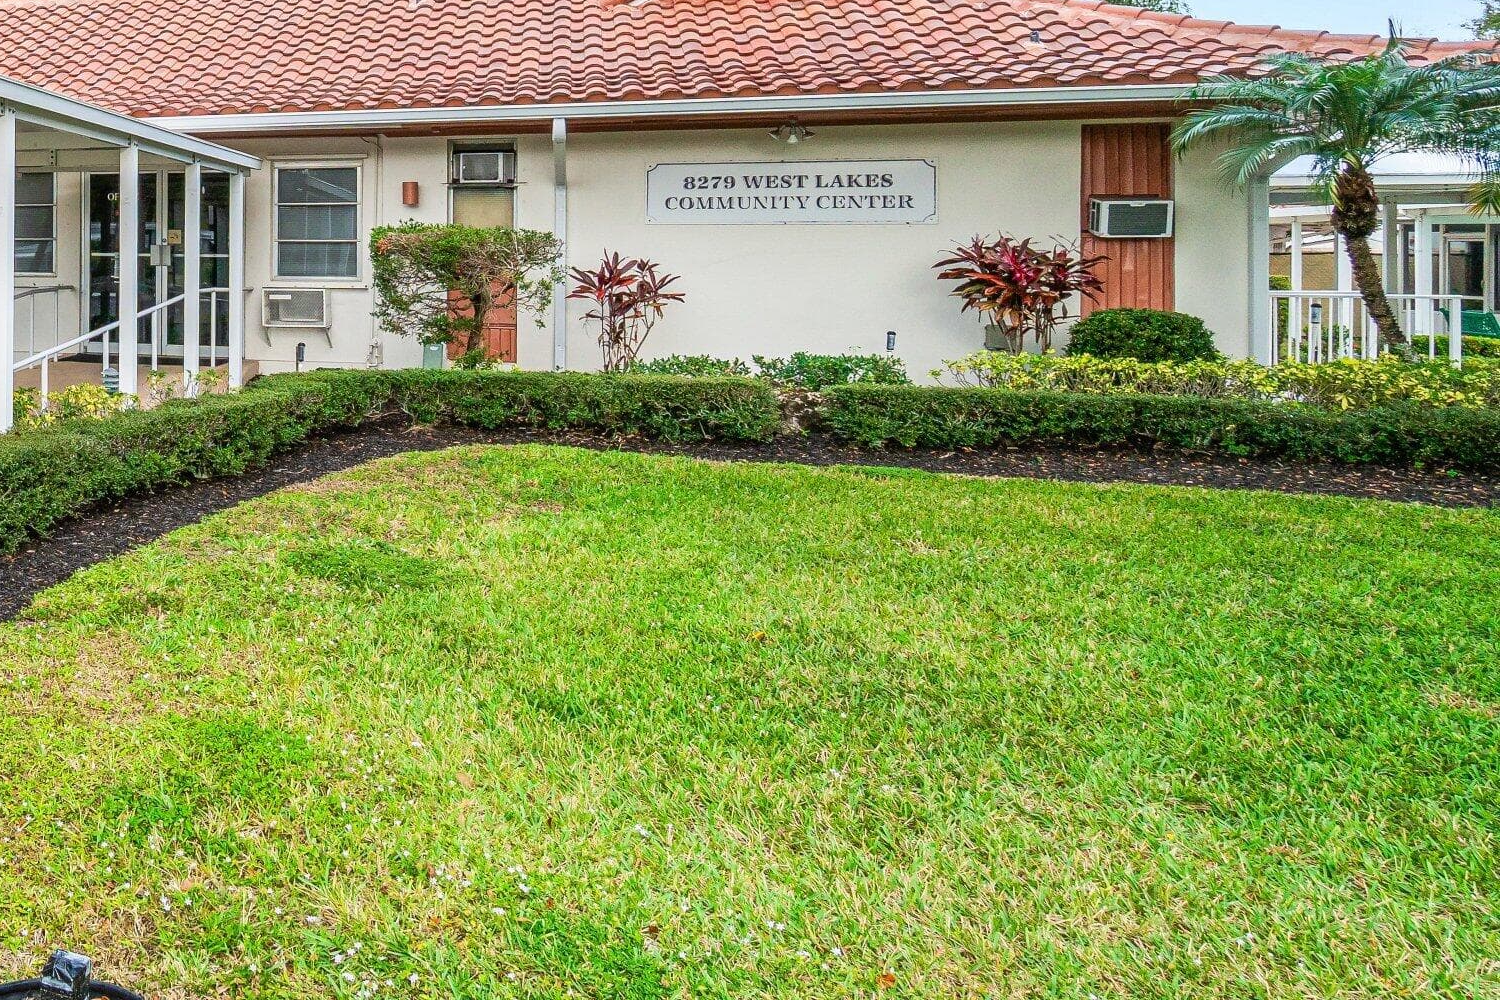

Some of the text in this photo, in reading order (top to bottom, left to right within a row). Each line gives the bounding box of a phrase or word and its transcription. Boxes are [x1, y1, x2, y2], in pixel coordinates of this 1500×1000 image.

[683, 174, 893, 190] 8279 WEST LAKES
[665, 194, 915, 210] COMMUNITY CENTER
